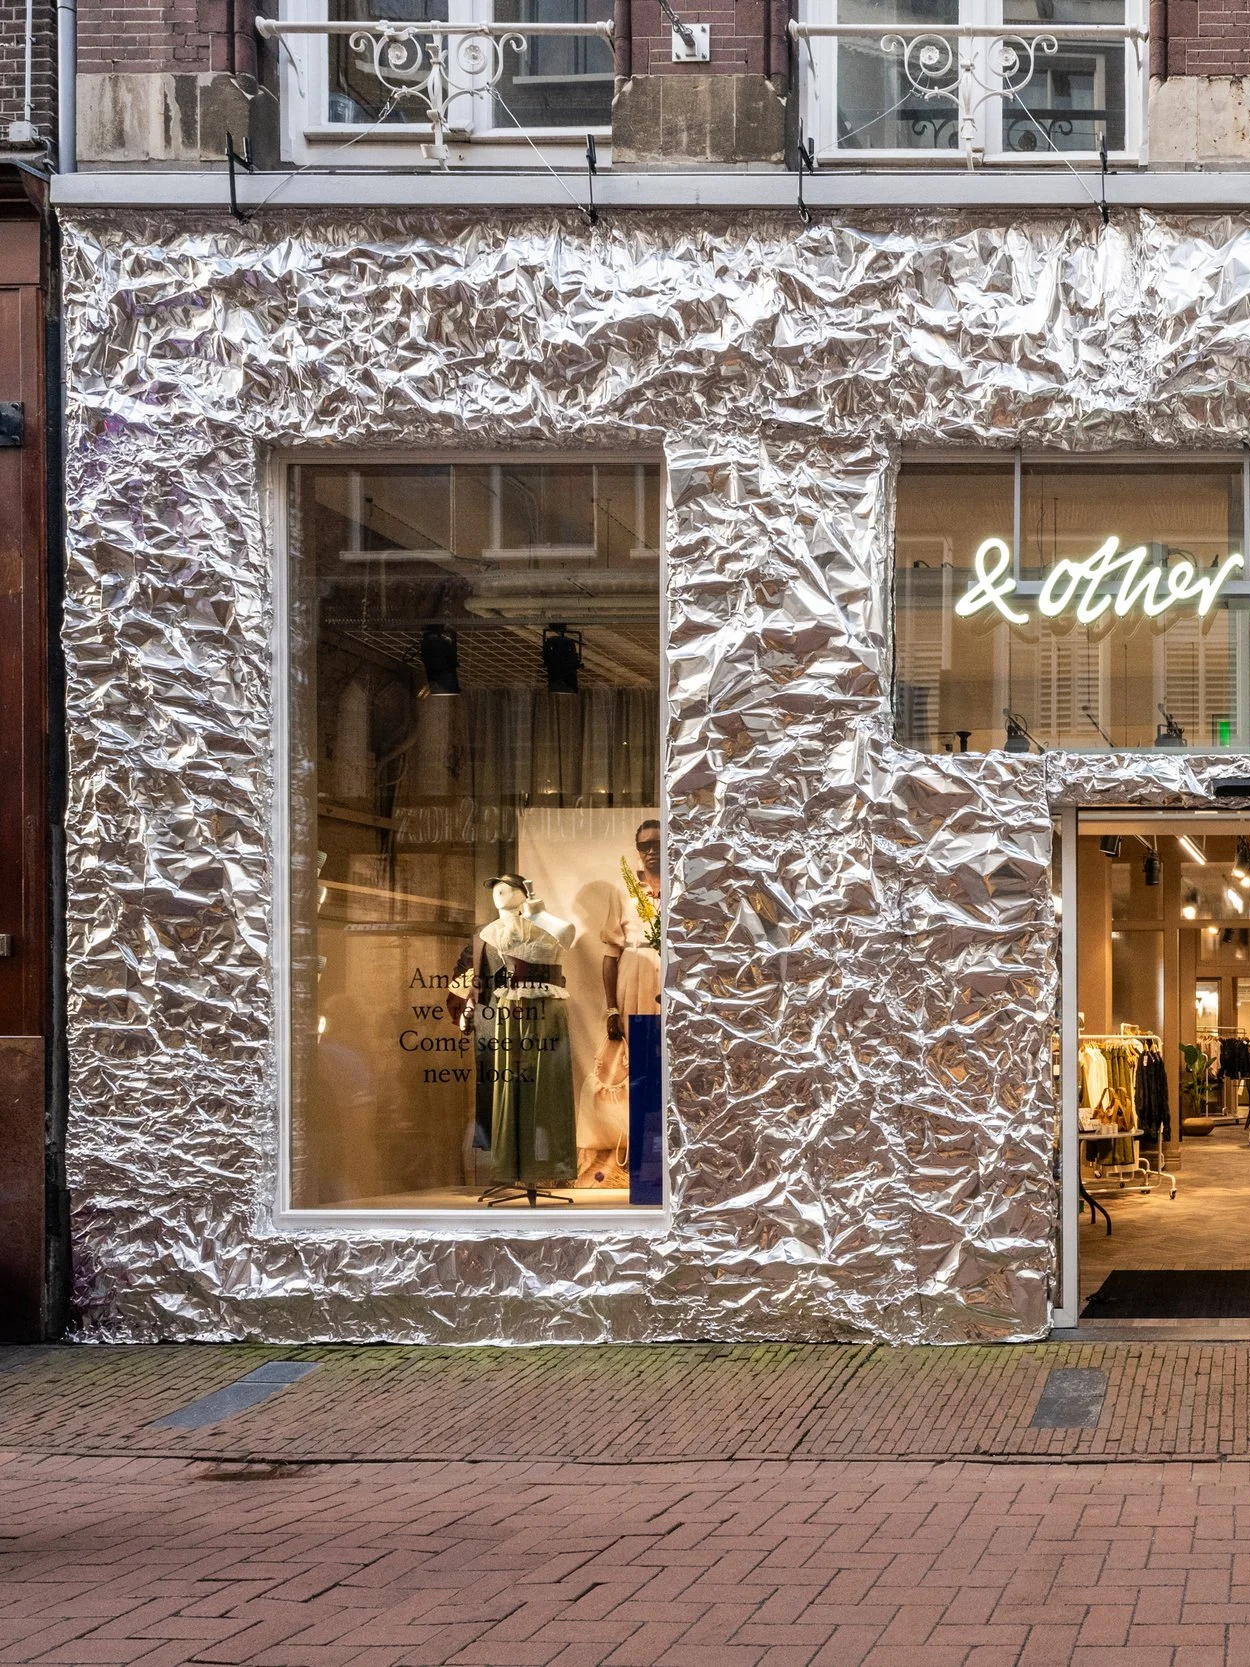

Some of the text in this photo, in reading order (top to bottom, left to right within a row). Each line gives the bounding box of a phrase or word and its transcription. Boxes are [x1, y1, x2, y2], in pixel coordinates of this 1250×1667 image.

[955, 537, 1030, 625] &
[1038, 534, 1244, 625] other
[412, 1000, 546, 1026] were open!
[399, 1030, 560, 1052] Come see our
[424, 1068, 472, 1083] new
